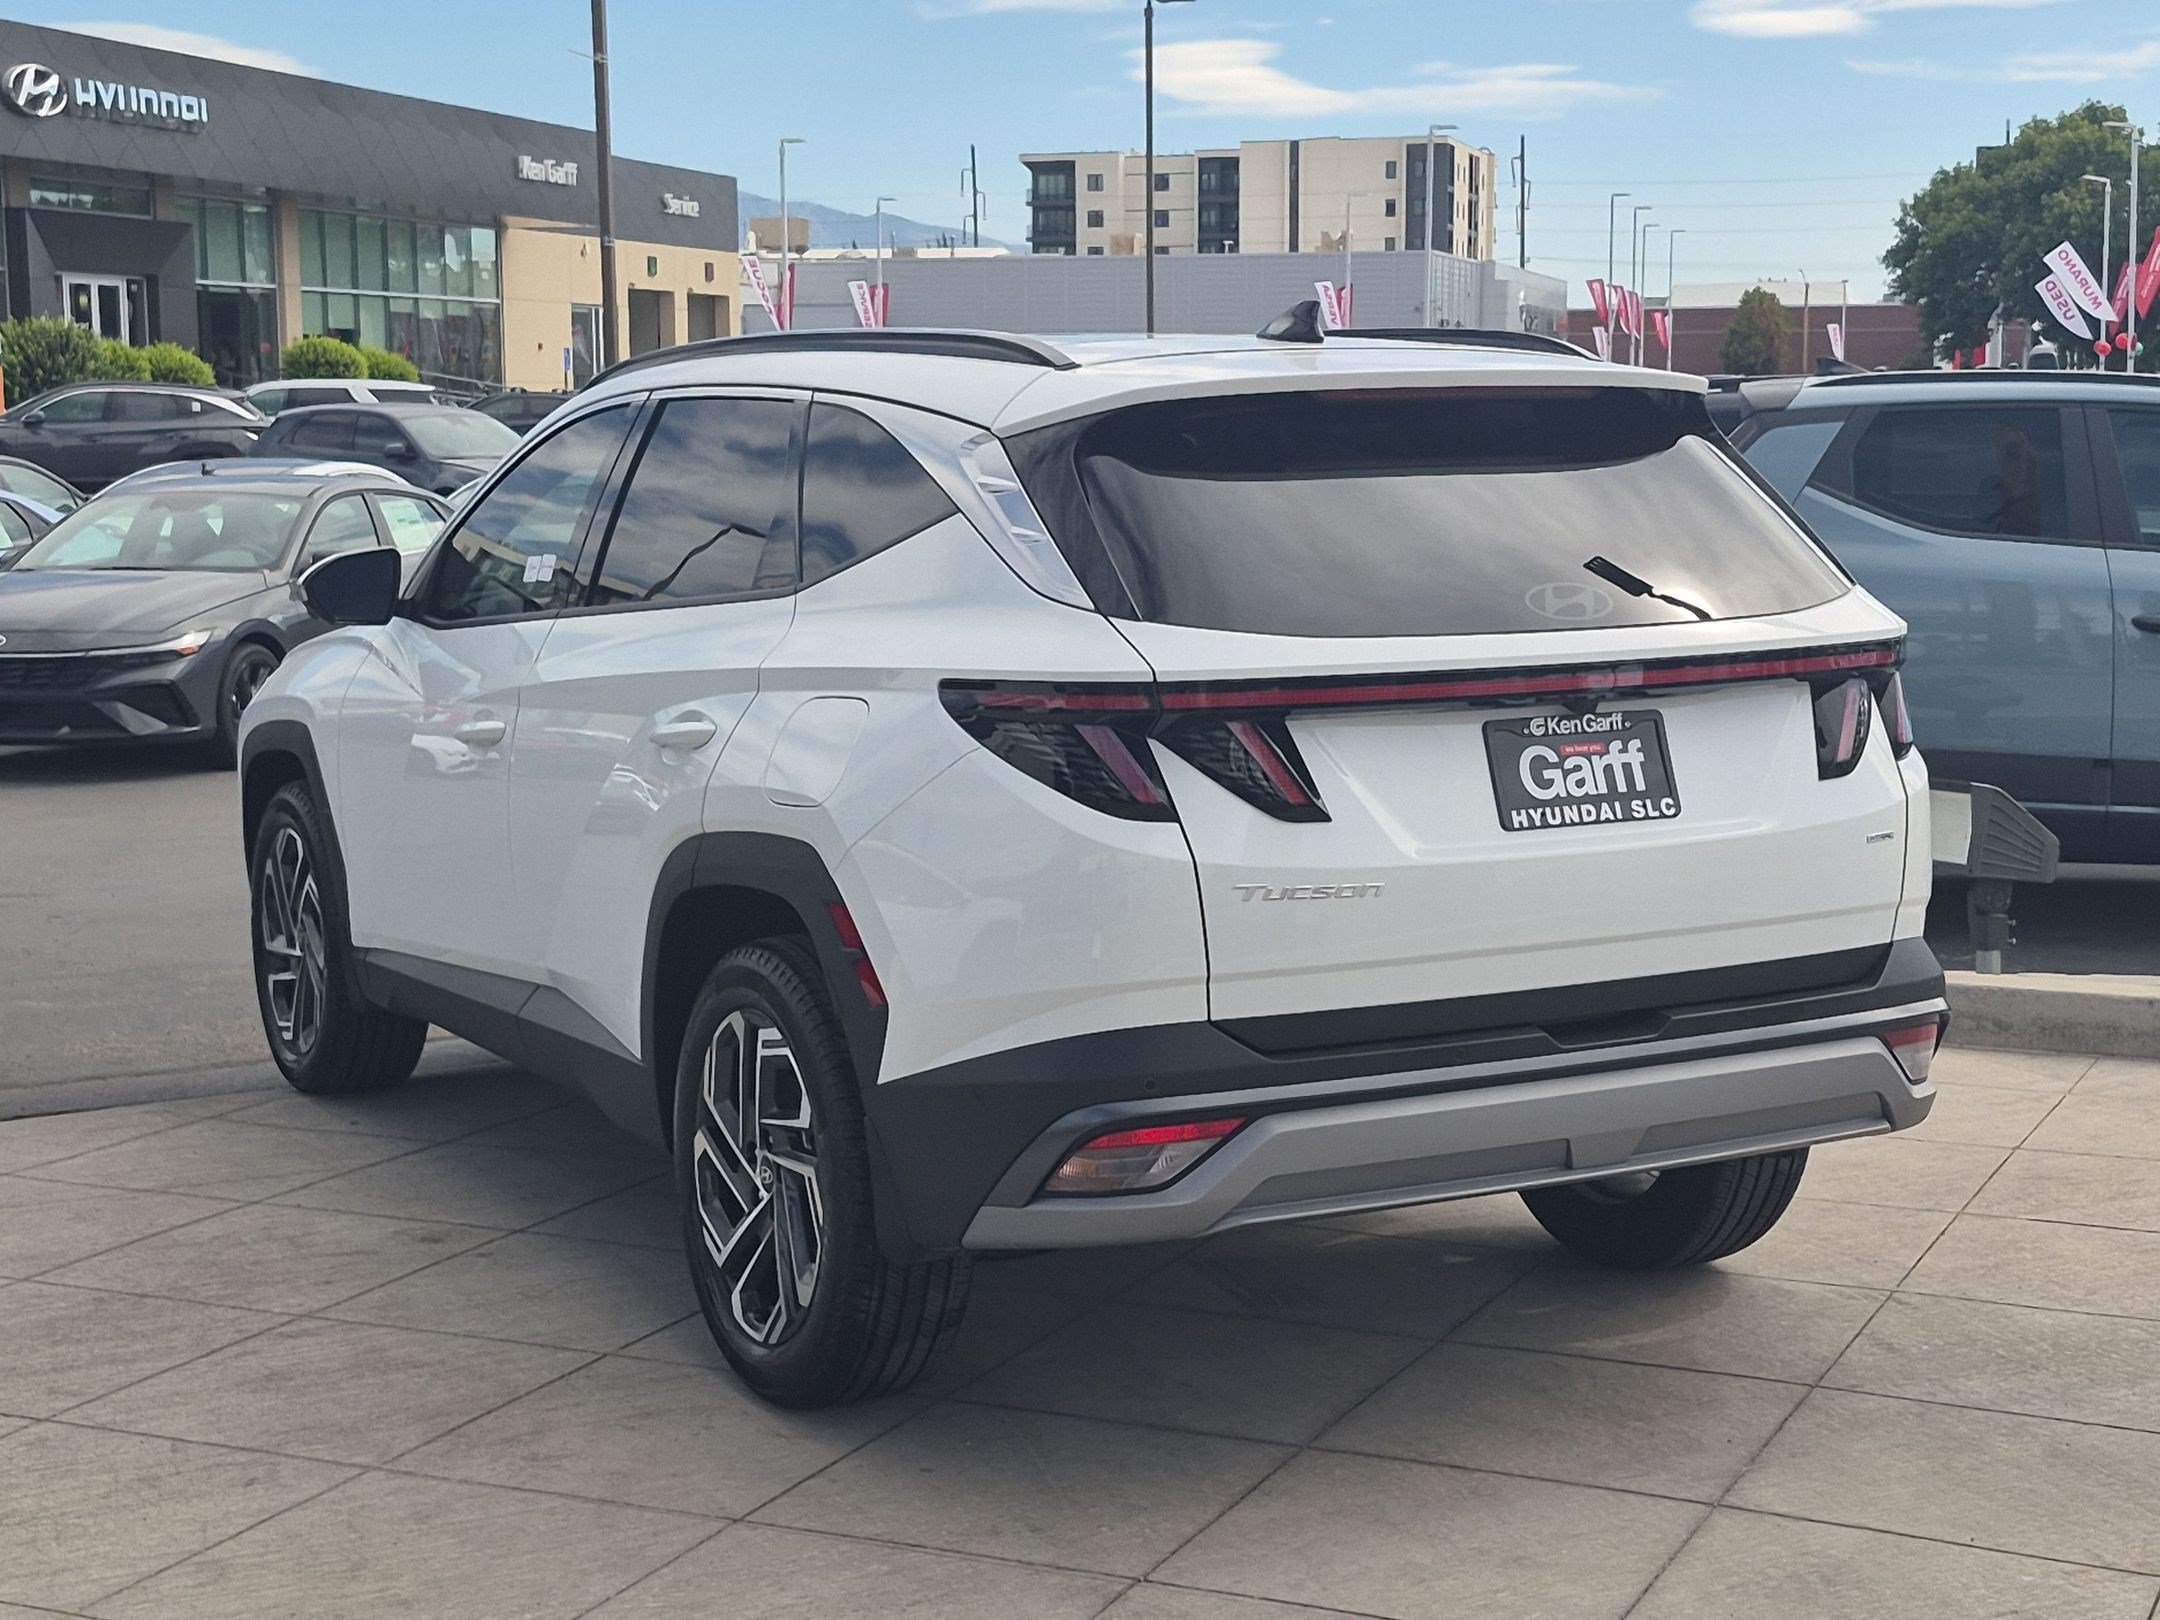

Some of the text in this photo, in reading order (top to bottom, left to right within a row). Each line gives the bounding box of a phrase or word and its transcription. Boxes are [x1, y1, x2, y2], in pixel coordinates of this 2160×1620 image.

[74, 77, 208, 123] HYUNDAI
[663, 193, 700, 217] Service
[1519, 739, 1646, 801] Garff
[1511, 797, 1676, 829] HYUNDAI SLC
